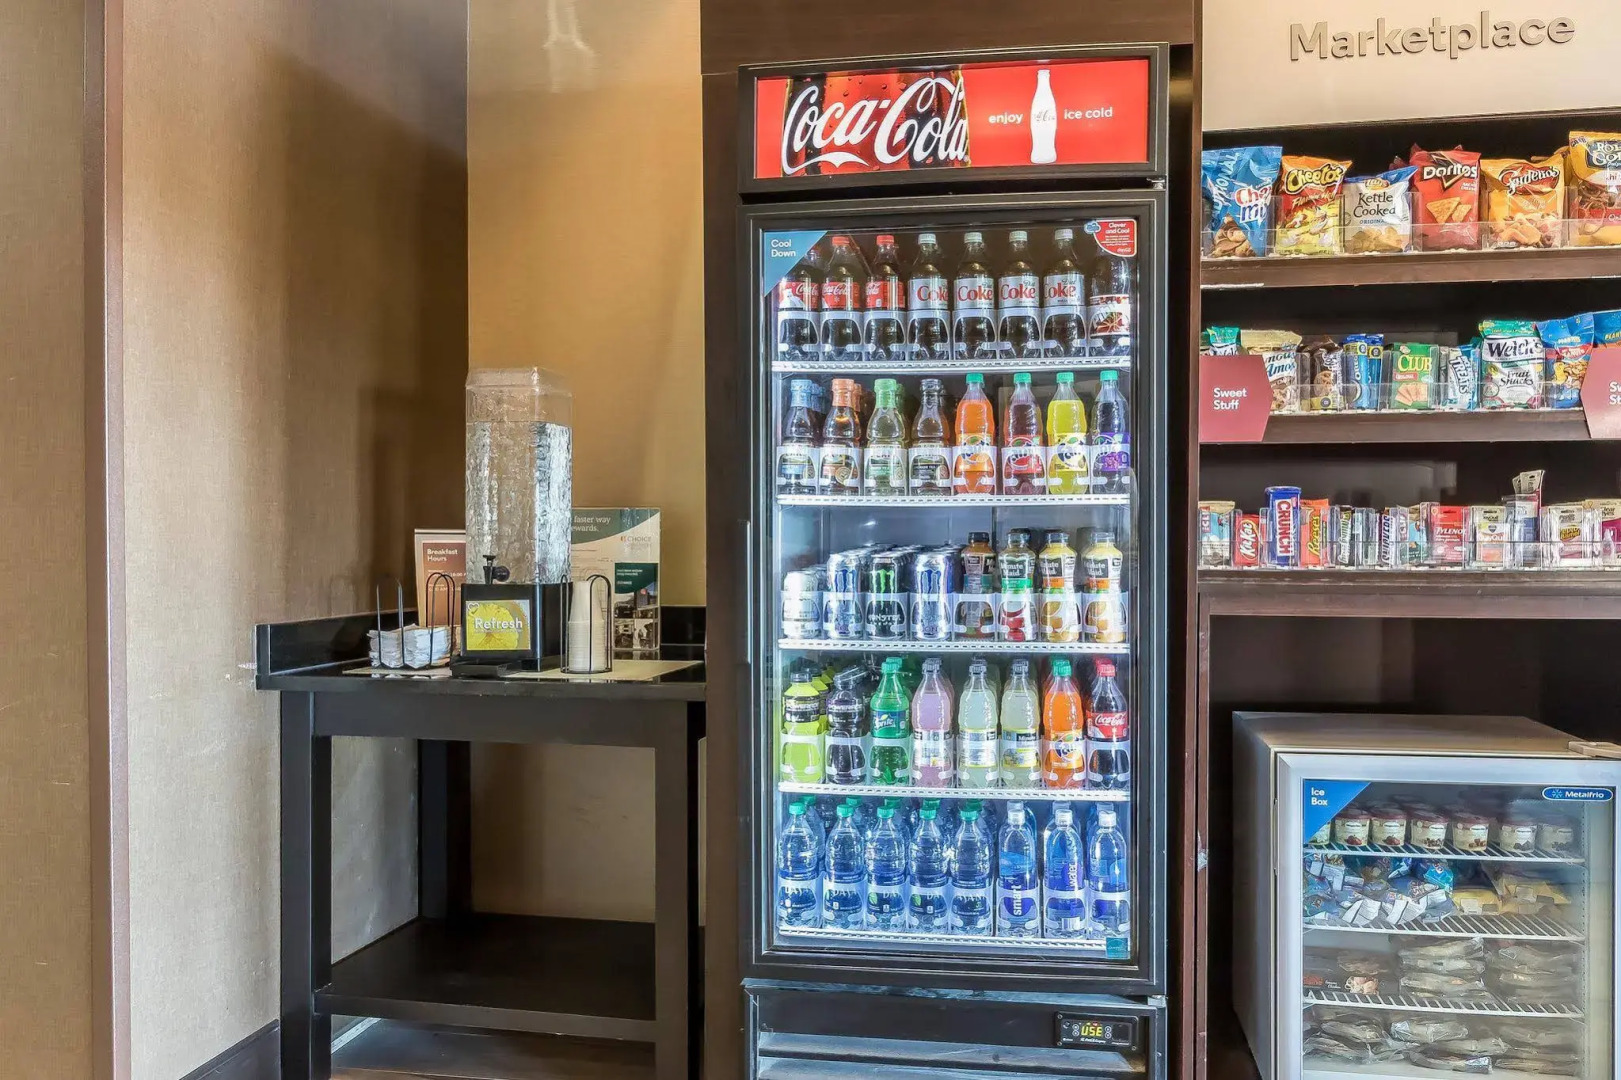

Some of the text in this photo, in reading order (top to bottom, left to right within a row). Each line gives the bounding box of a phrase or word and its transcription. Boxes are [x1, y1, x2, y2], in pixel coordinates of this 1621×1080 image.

[1289, 10, 1576, 61] Marketplace
[988, 106, 1114, 125] enjoy ice cold
[782, 76, 969, 174] Coca-Cola
[1285, 163, 1344, 194] Cheetos
[1423, 164, 1478, 180] Doritos
[1358, 192, 1394, 206] Kettle
[1353, 204, 1396, 218] Cooked
[771, 238, 792, 248] Cool
[771, 249, 796, 257] Down
[958, 285, 993, 302] Coke
[1000, 283, 1036, 300] Coke
[1487, 338, 1543, 358] Welch's
[1397, 354, 1432, 371] CLUB
[1449, 356, 1470, 394] TREATS
[1507, 369, 1531, 379] Fruit
[1500, 377, 1534, 387] Snacks
[1213, 387, 1247, 398] Sweet
[1213, 399, 1240, 410] Stuff
[574, 515, 594, 523] faster
[1277, 500, 1292, 554] CRUNCH
[475, 617, 523, 630] Refresh
[1095, 712, 1127, 726] Coca-Cola
[1311, 787, 1325, 796] Ice
[1564, 791, 1605, 799] Metalfrio
[1311, 797, 1328, 806] Box
[1069, 863, 1077, 887] water
[1013, 884, 1022, 917] smart
